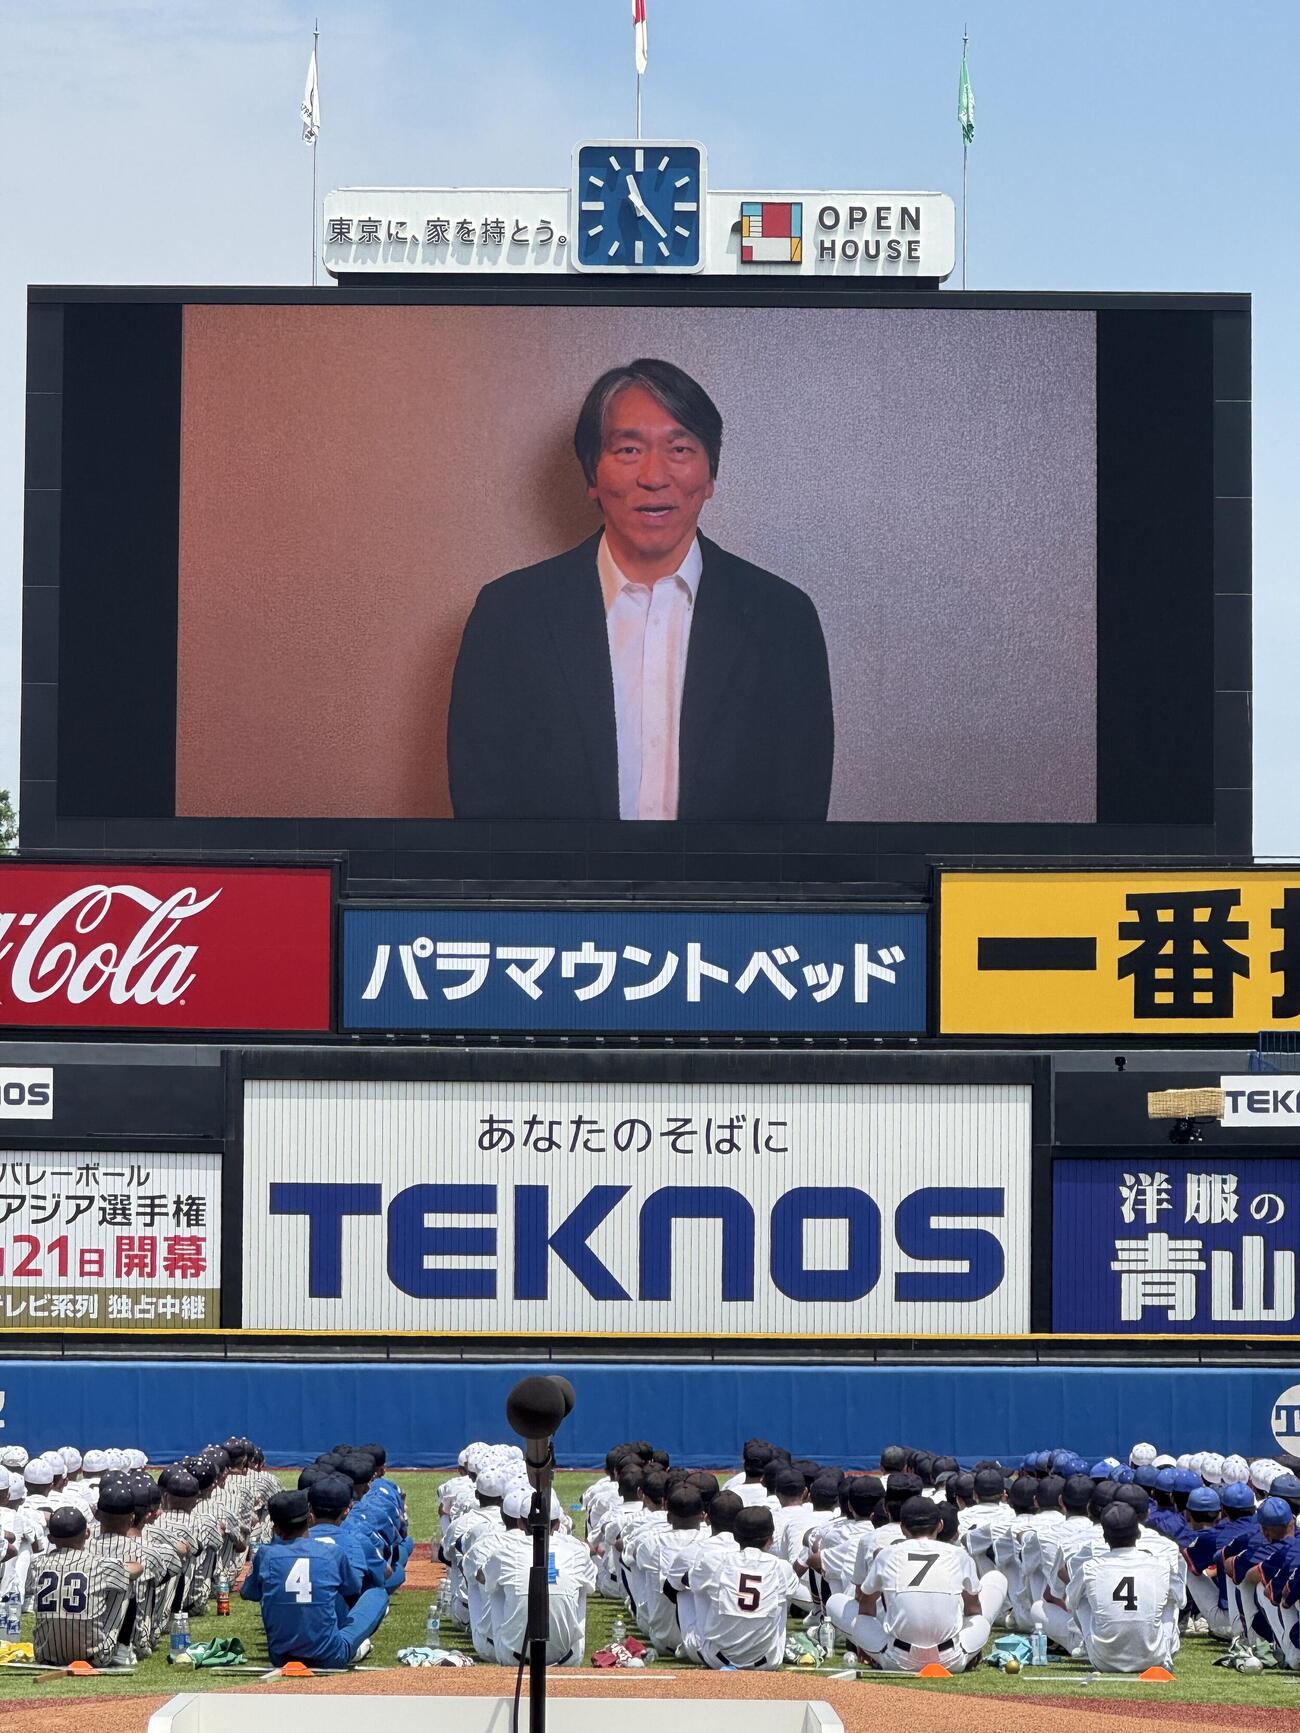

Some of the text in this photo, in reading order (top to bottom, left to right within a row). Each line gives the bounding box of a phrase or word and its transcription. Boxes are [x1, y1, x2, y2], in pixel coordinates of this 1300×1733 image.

[329, 217, 567, 243] 東京に、家を持とう。
[818, 206, 921, 231] OPEN
[820, 239, 921, 261] HOUSE
[362, 936, 905, 1003] パラマウントベッド
[0, 1082, 50, 1106] OS
[1226, 1090, 1300, 1113] TEK
[477, 1114, 789, 1155] あなたのそばに
[0, 1162, 151, 1188] バレーボール
[0, 1194, 207, 1228] アジア選手権
[1119, 1172, 1285, 1226] 洋服の
[269, 1182, 1005, 1303] TEKNOS
[1110, 1232, 1295, 1322] 青山
[0, 1294, 99, 1320] レビ系列
[284, 1557, 312, 1603] 4
[907, 1552, 937, 1588] 7
[37, 1570, 88, 1614] 23
[738, 1573, 763, 1612] 5
[1112, 1576, 1139, 1611] 4
